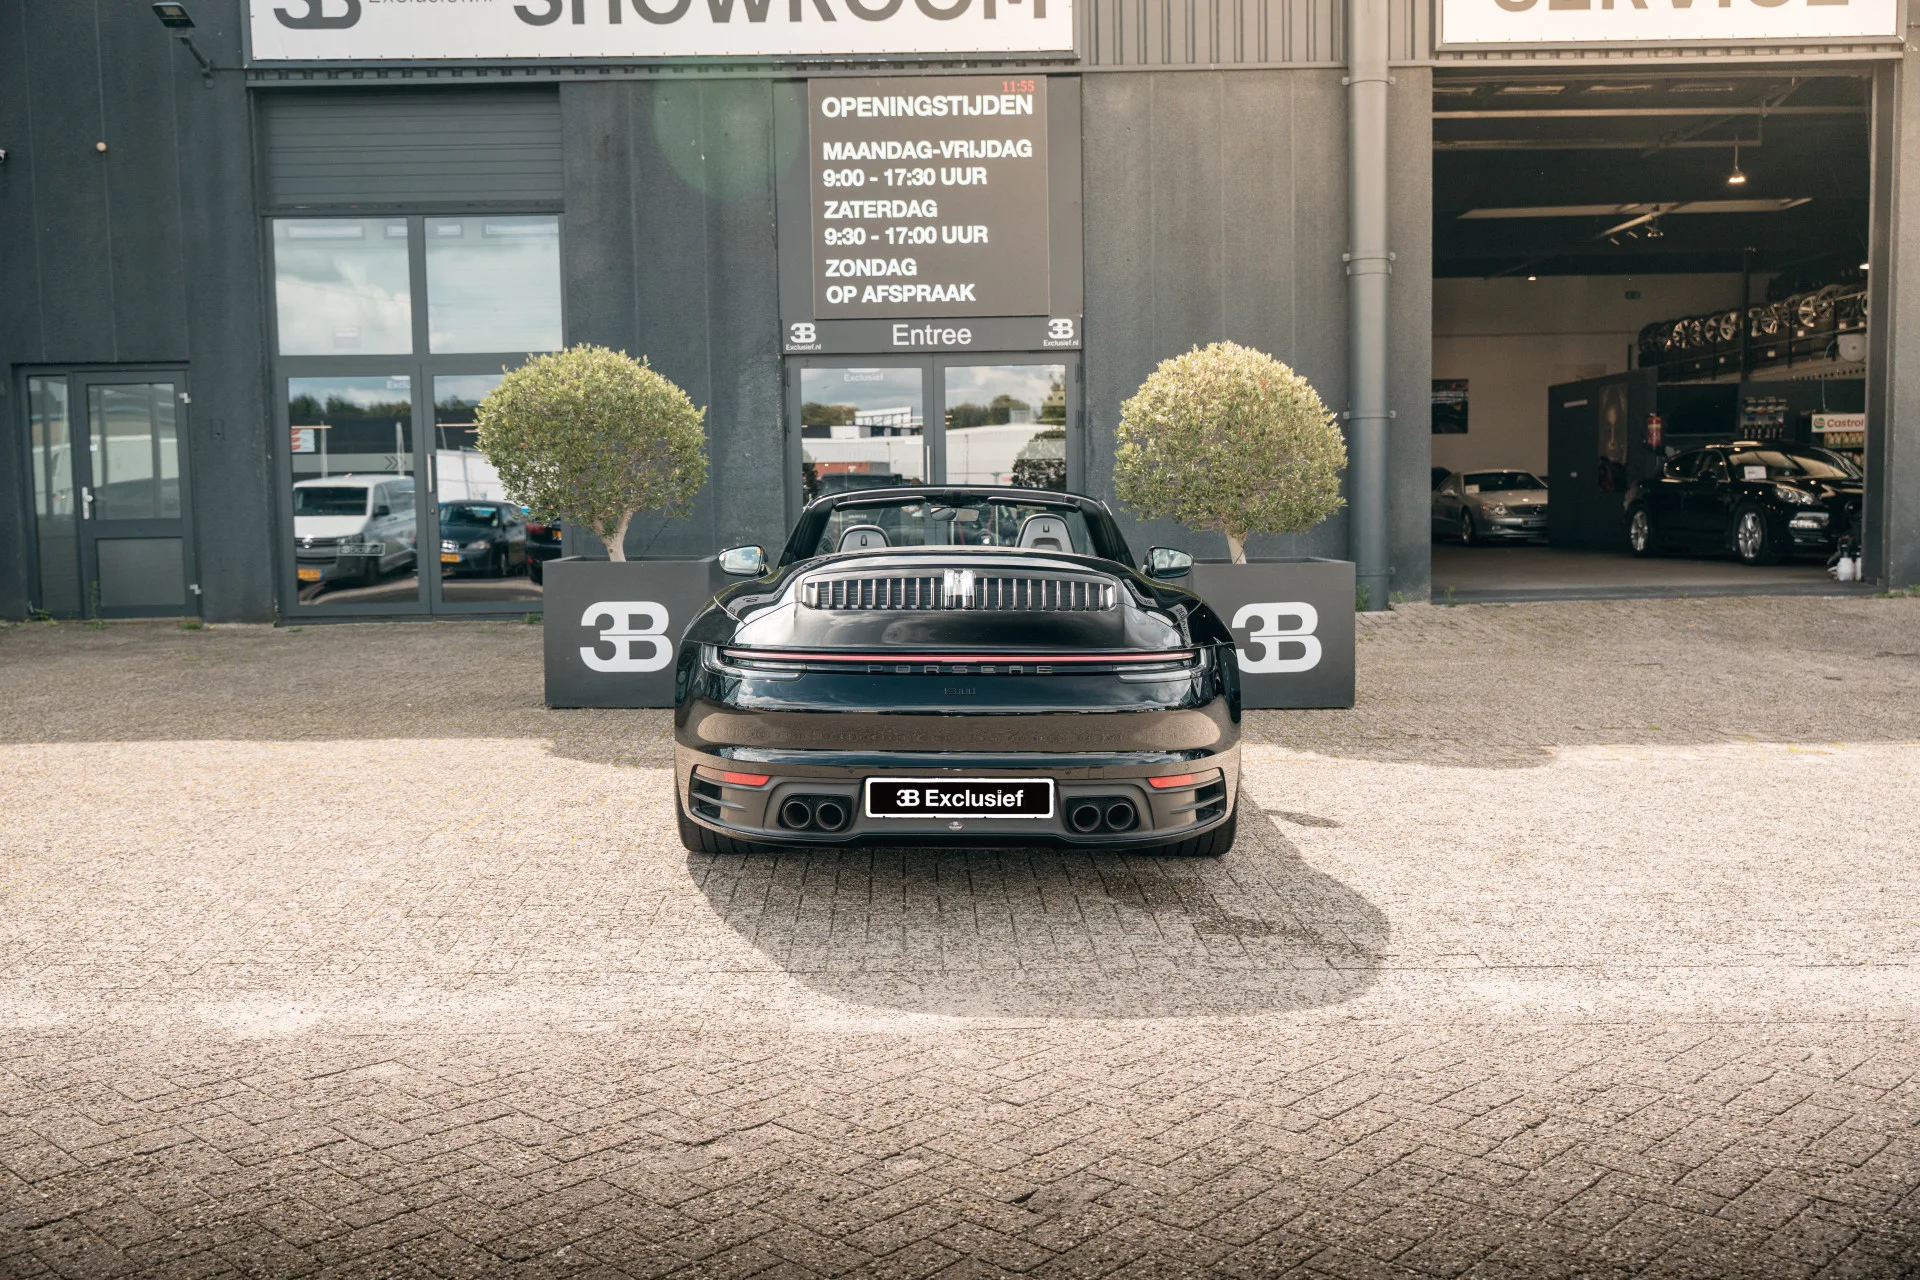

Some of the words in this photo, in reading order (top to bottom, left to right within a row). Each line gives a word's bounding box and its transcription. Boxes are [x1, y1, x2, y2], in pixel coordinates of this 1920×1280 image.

[1002, 80, 1035, 93] 11:55
[821, 95, 1033, 117] OPENINGSTIJDEN
[823, 139, 1033, 160] MAANDAG-VRIJDAG
[822, 169, 865, 187] 9:00
[884, 168, 936, 186] 17:30
[940, 167, 987, 185] UUR
[824, 200, 938, 218] ZATERDAG
[824, 228, 866, 246] 9:30
[885, 227, 938, 244] 17:00
[942, 226, 989, 244] UUR
[825, 258, 918, 277] ZONDAG
[826, 286, 857, 304] OP
[861, 284, 976, 303] AFSPRAAK
[892, 324, 972, 346] Entree
[1827, 419, 1864, 428] Castrol
[867, 665, 1053, 674] PORSCHE
[925, 789, 1024, 807] Exclusief
